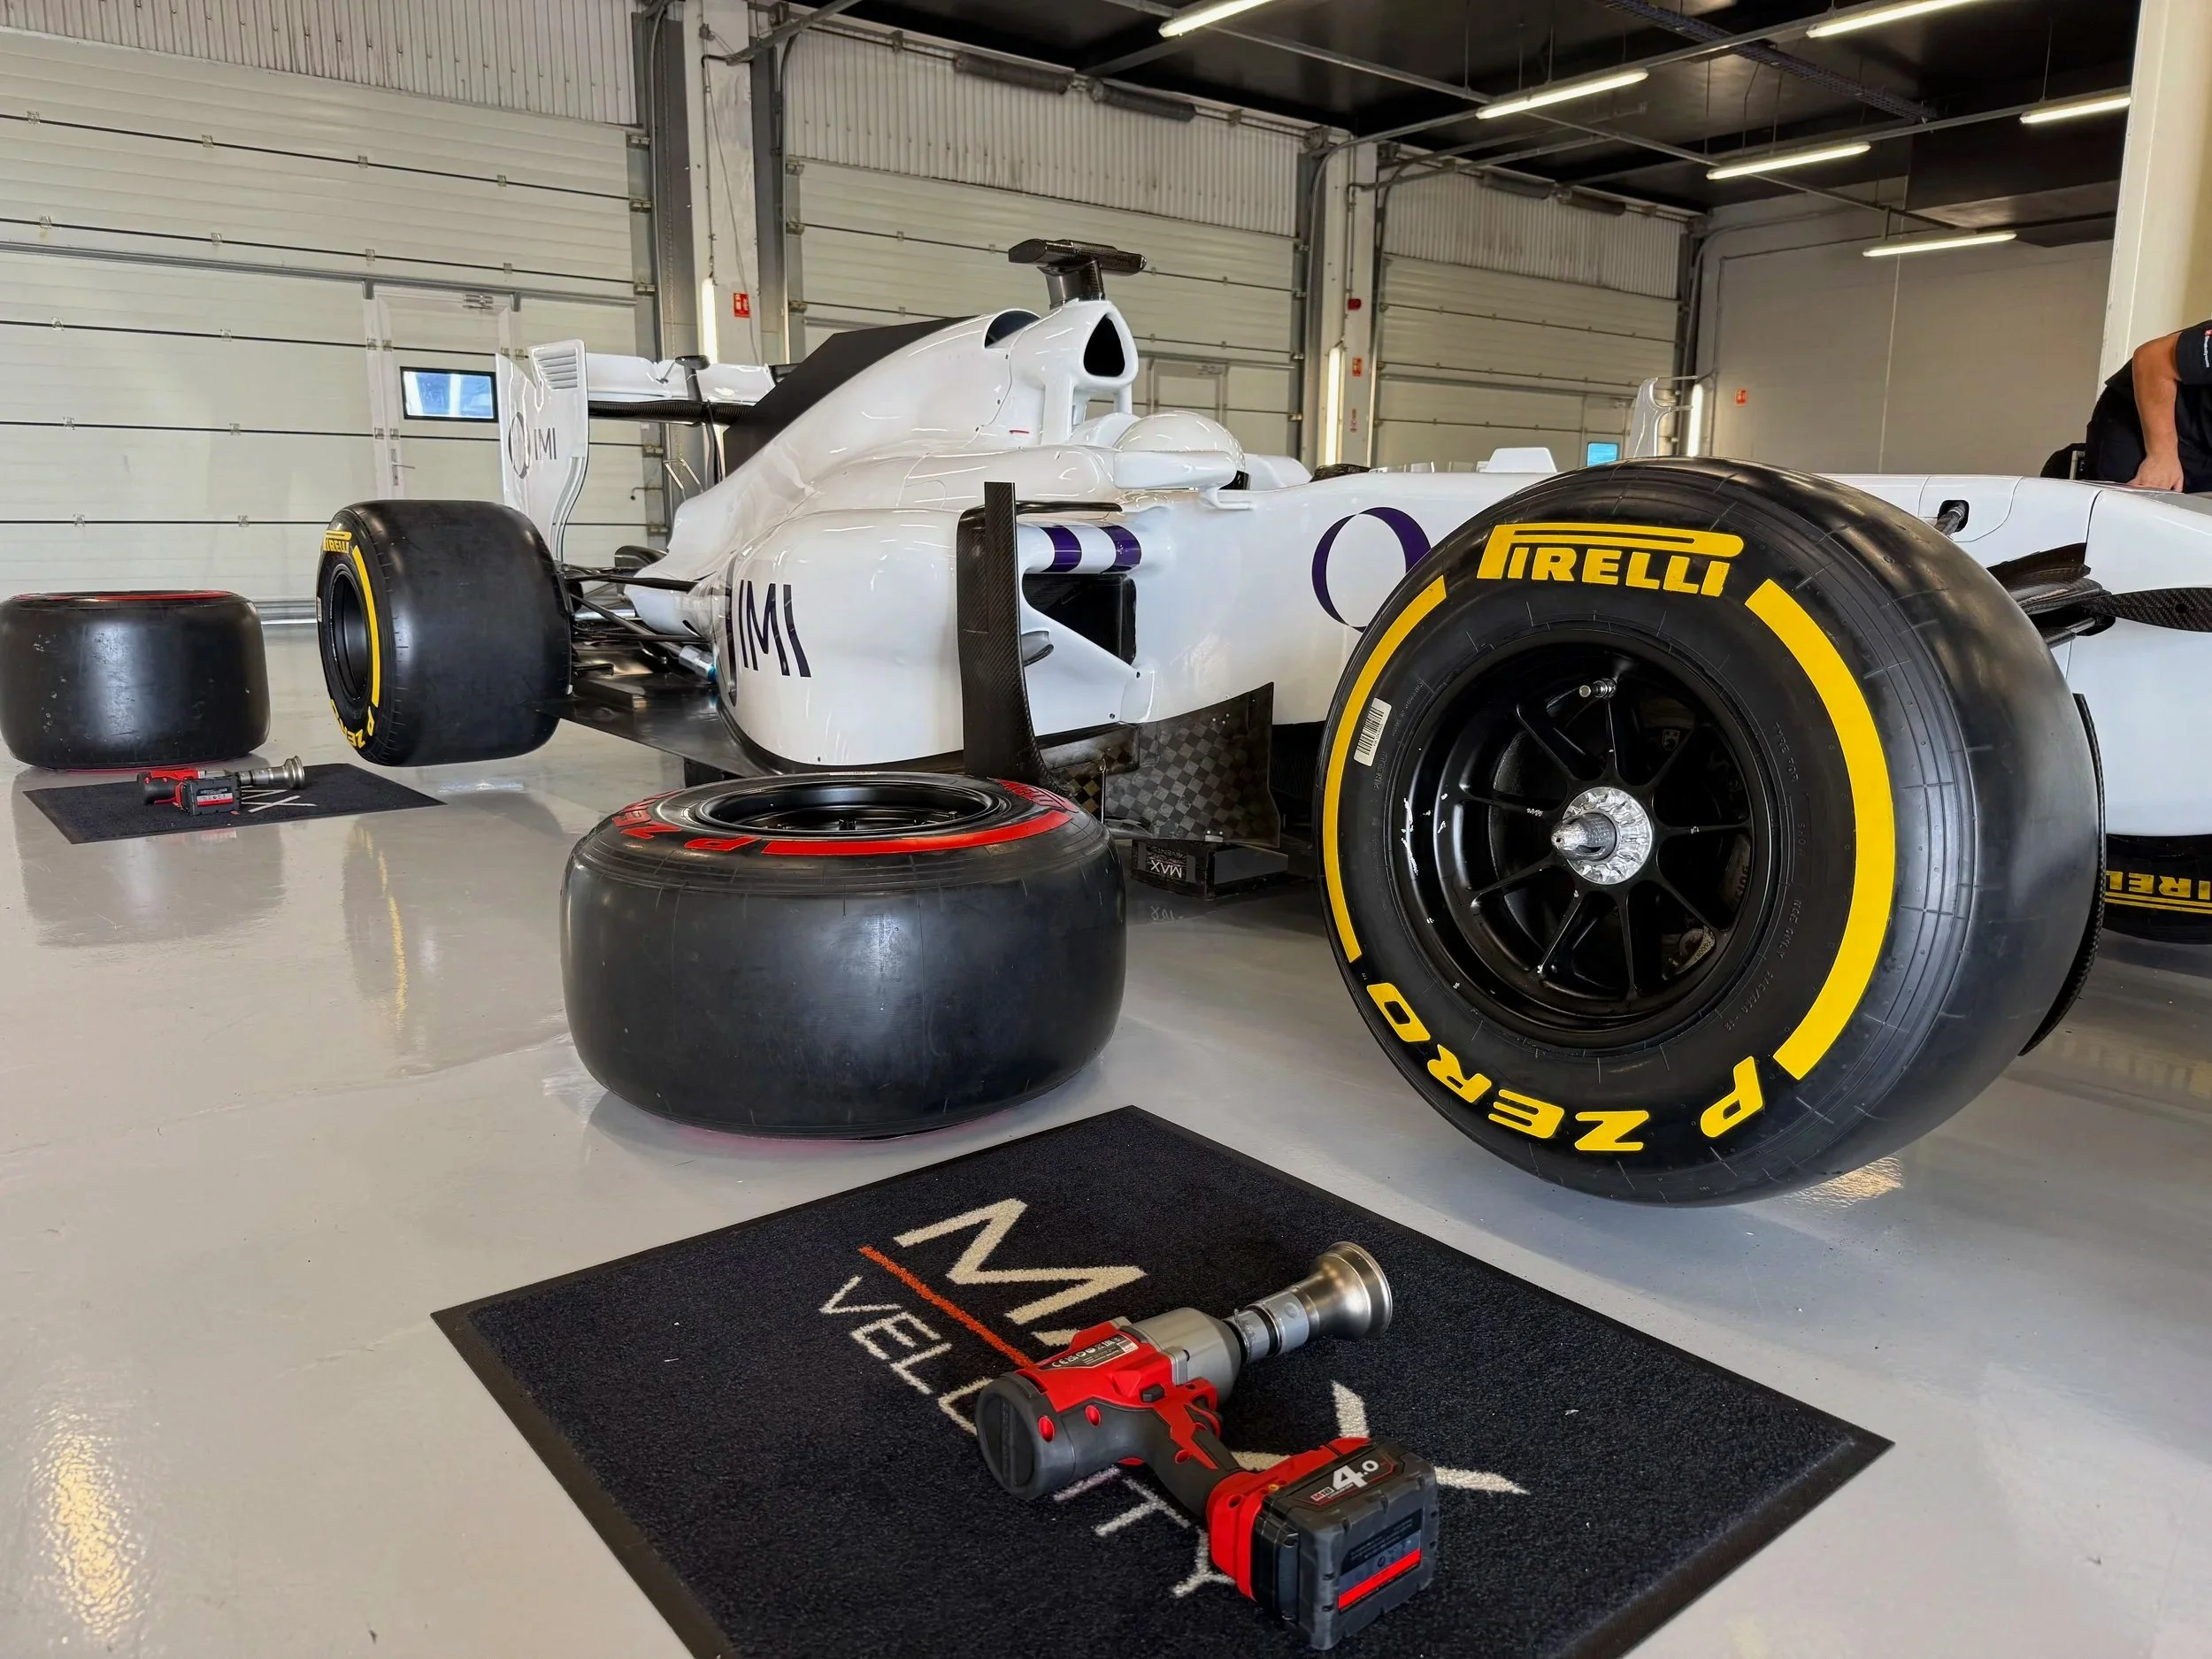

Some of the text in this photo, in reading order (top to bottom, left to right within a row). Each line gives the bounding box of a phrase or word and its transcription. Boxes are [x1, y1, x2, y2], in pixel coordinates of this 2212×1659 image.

[323, 530, 352, 554] PIRELLI
[1477, 522, 1744, 597] PIRELLI
[738, 580, 812, 678] IMI
[1373, 751, 1387, 790] PIRELLI
[683, 834, 763, 852] P
[1150, 859, 1182, 879] MAX
[2105, 870, 2212, 913] IREL
[1366, 981, 1764, 1152] P ZERO
[818, 1275, 1239, 1599] VELITY
[1333, 1460, 1379, 1490] 4.0
